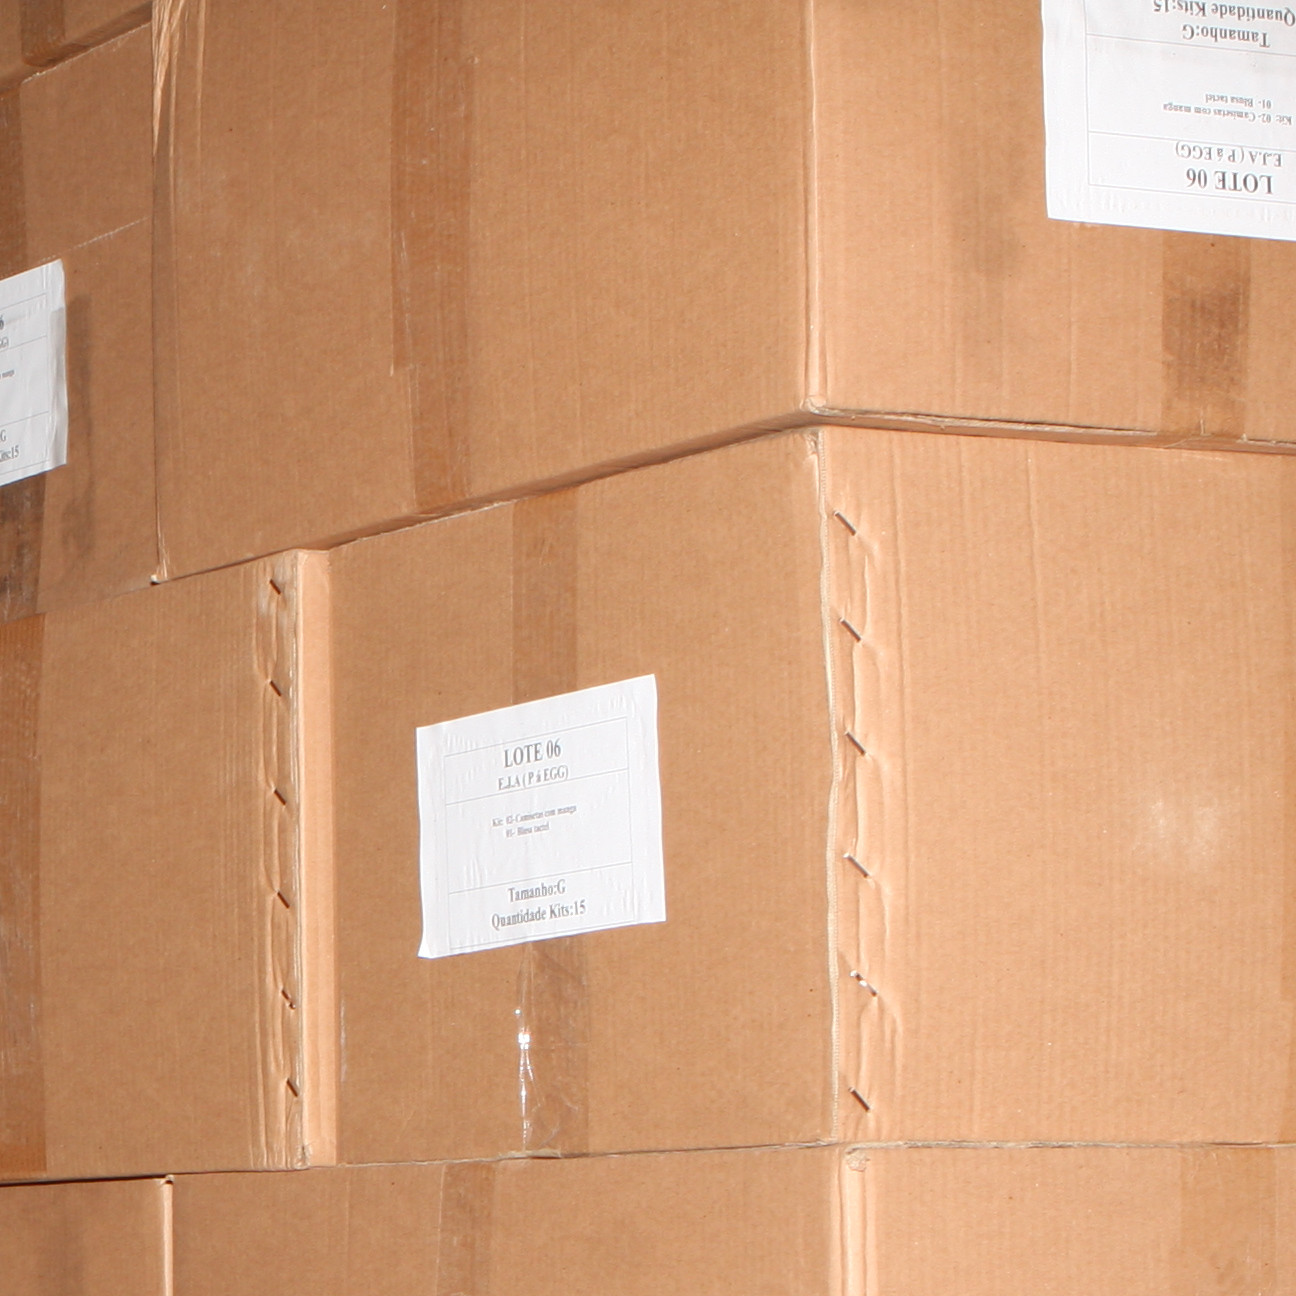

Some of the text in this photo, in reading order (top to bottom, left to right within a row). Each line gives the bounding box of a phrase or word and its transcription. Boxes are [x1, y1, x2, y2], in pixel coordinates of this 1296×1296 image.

[1211, 3, 1296, 27] Quantidade
[1182, 24, 1271, 48] Tamanho:G
[1185, 167, 1273, 195] LOTE 06
[504, 738, 561, 768] LOTE 06
[508, 878, 566, 902] Tamanho:G
[491, 899, 586, 931] Quantidade Kits:15
